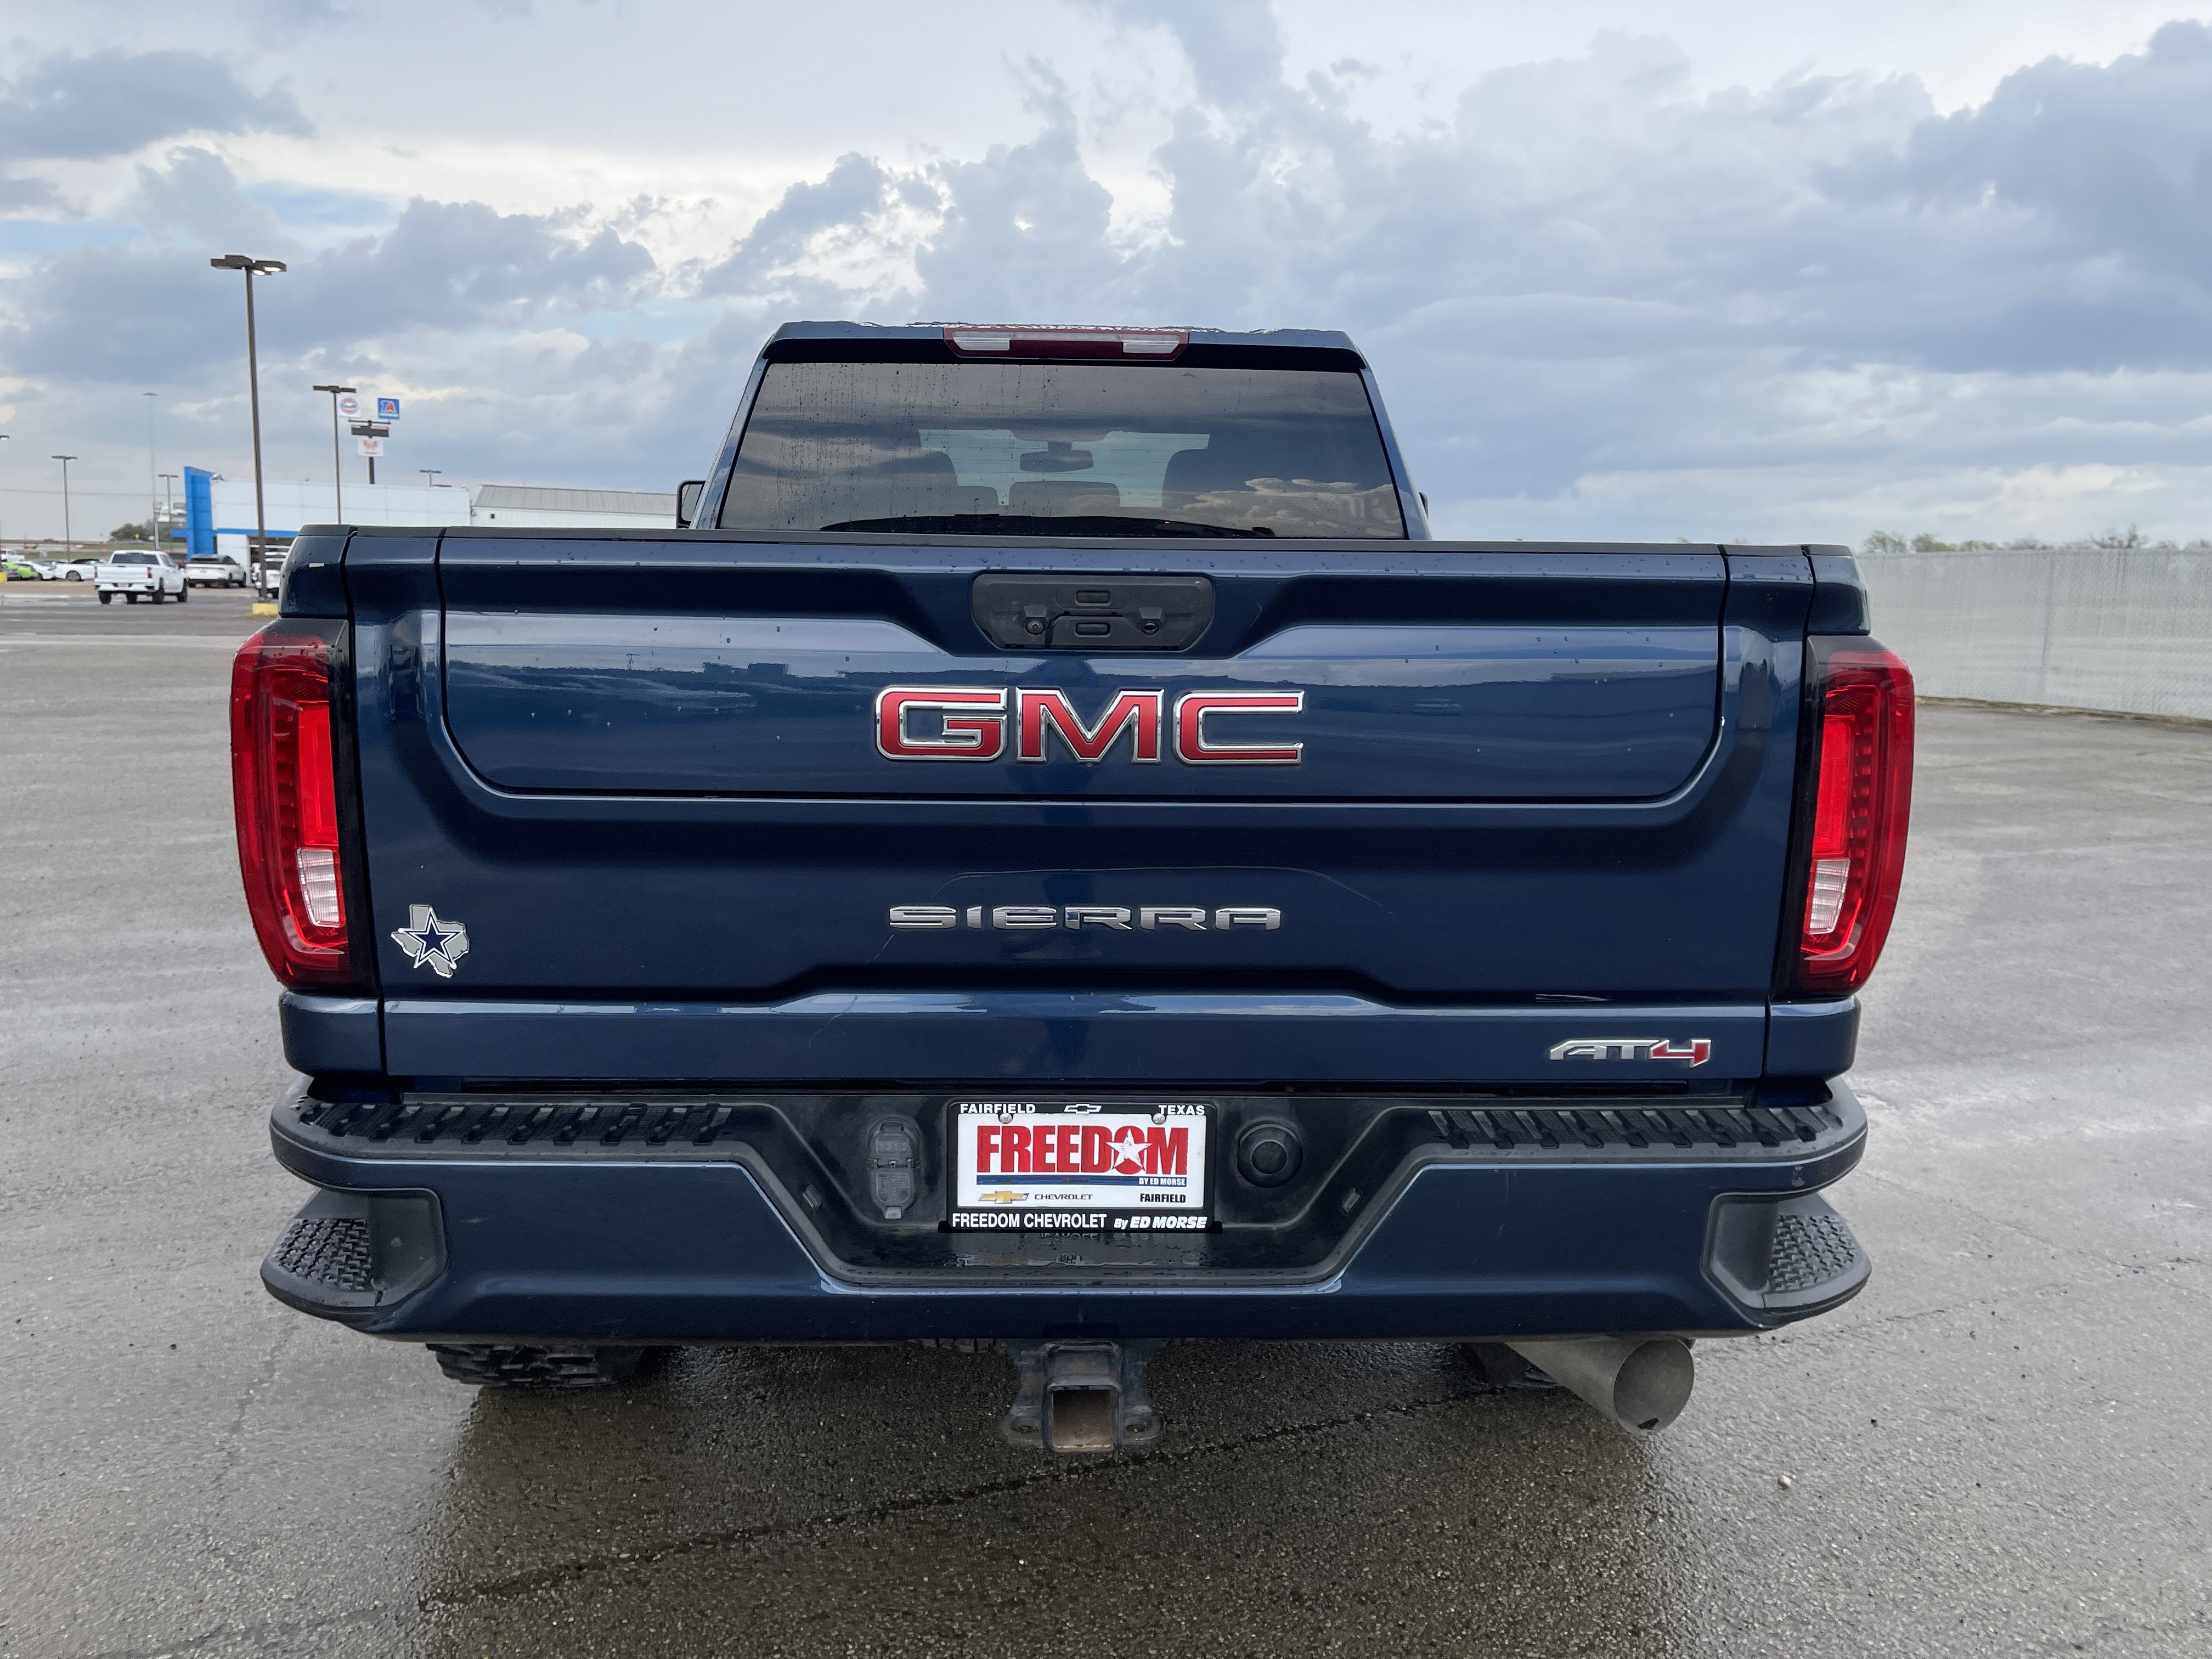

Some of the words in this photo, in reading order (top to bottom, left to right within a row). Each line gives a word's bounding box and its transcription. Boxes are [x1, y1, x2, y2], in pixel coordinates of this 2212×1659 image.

[876, 686, 1305, 765] GMC
[889, 905, 1282, 931] SIERRA
[1549, 1039, 1712, 1068] AT4
[960, 1103, 1036, 1114] FAIRFIELD
[1158, 1104, 1205, 1116] TEXAS
[977, 1125, 1189, 1175] FREEDOM
[1160, 1177, 1186, 1186] MORSE
[1139, 1193, 1186, 1203] FAIRFIELD
[952, 1213, 1020, 1228] FREEDOM
[1024, 1214, 1107, 1228] CHEVROLET
[1114, 1217, 1128, 1230] By
[1129, 1216, 1151, 1229] ED
[1152, 1216, 1207, 1229] MORSE
